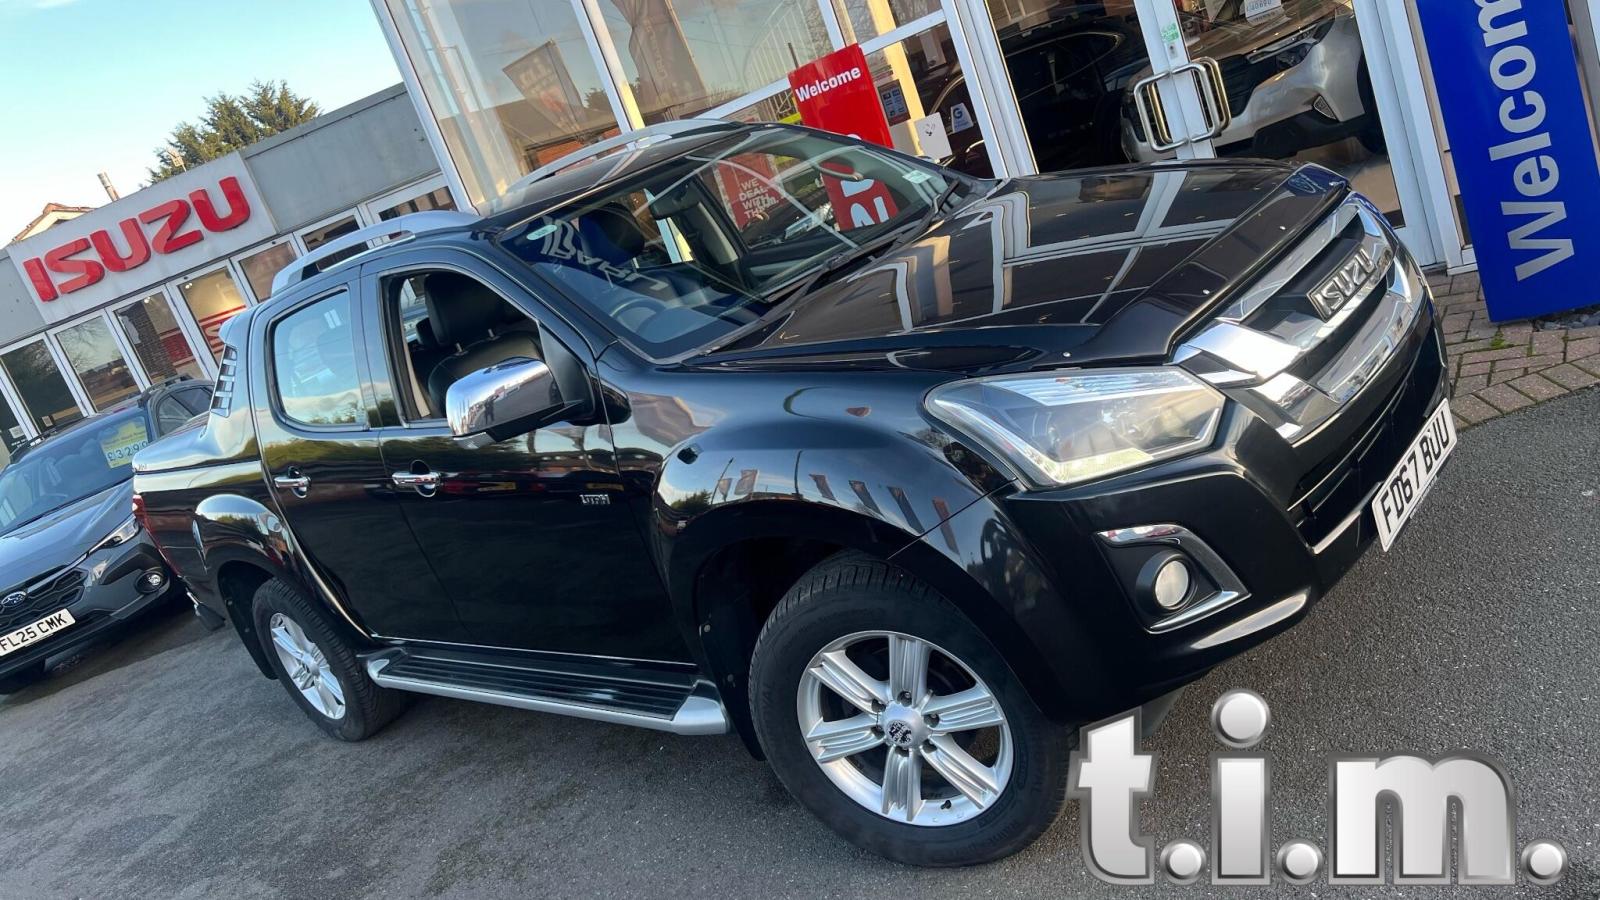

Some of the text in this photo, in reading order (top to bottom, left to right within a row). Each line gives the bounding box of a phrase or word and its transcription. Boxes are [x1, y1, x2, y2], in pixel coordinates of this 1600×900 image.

[795, 66, 862, 102] Welcome
[739, 185, 768, 201] DEAL
[741, 177, 760, 190] WE
[24, 176, 251, 302] ISUZU
[1314, 248, 1376, 316] ISUZU
[1380, 411, 1450, 534] FD67 BUU
[0, 613, 68, 651] FL25 CMK
